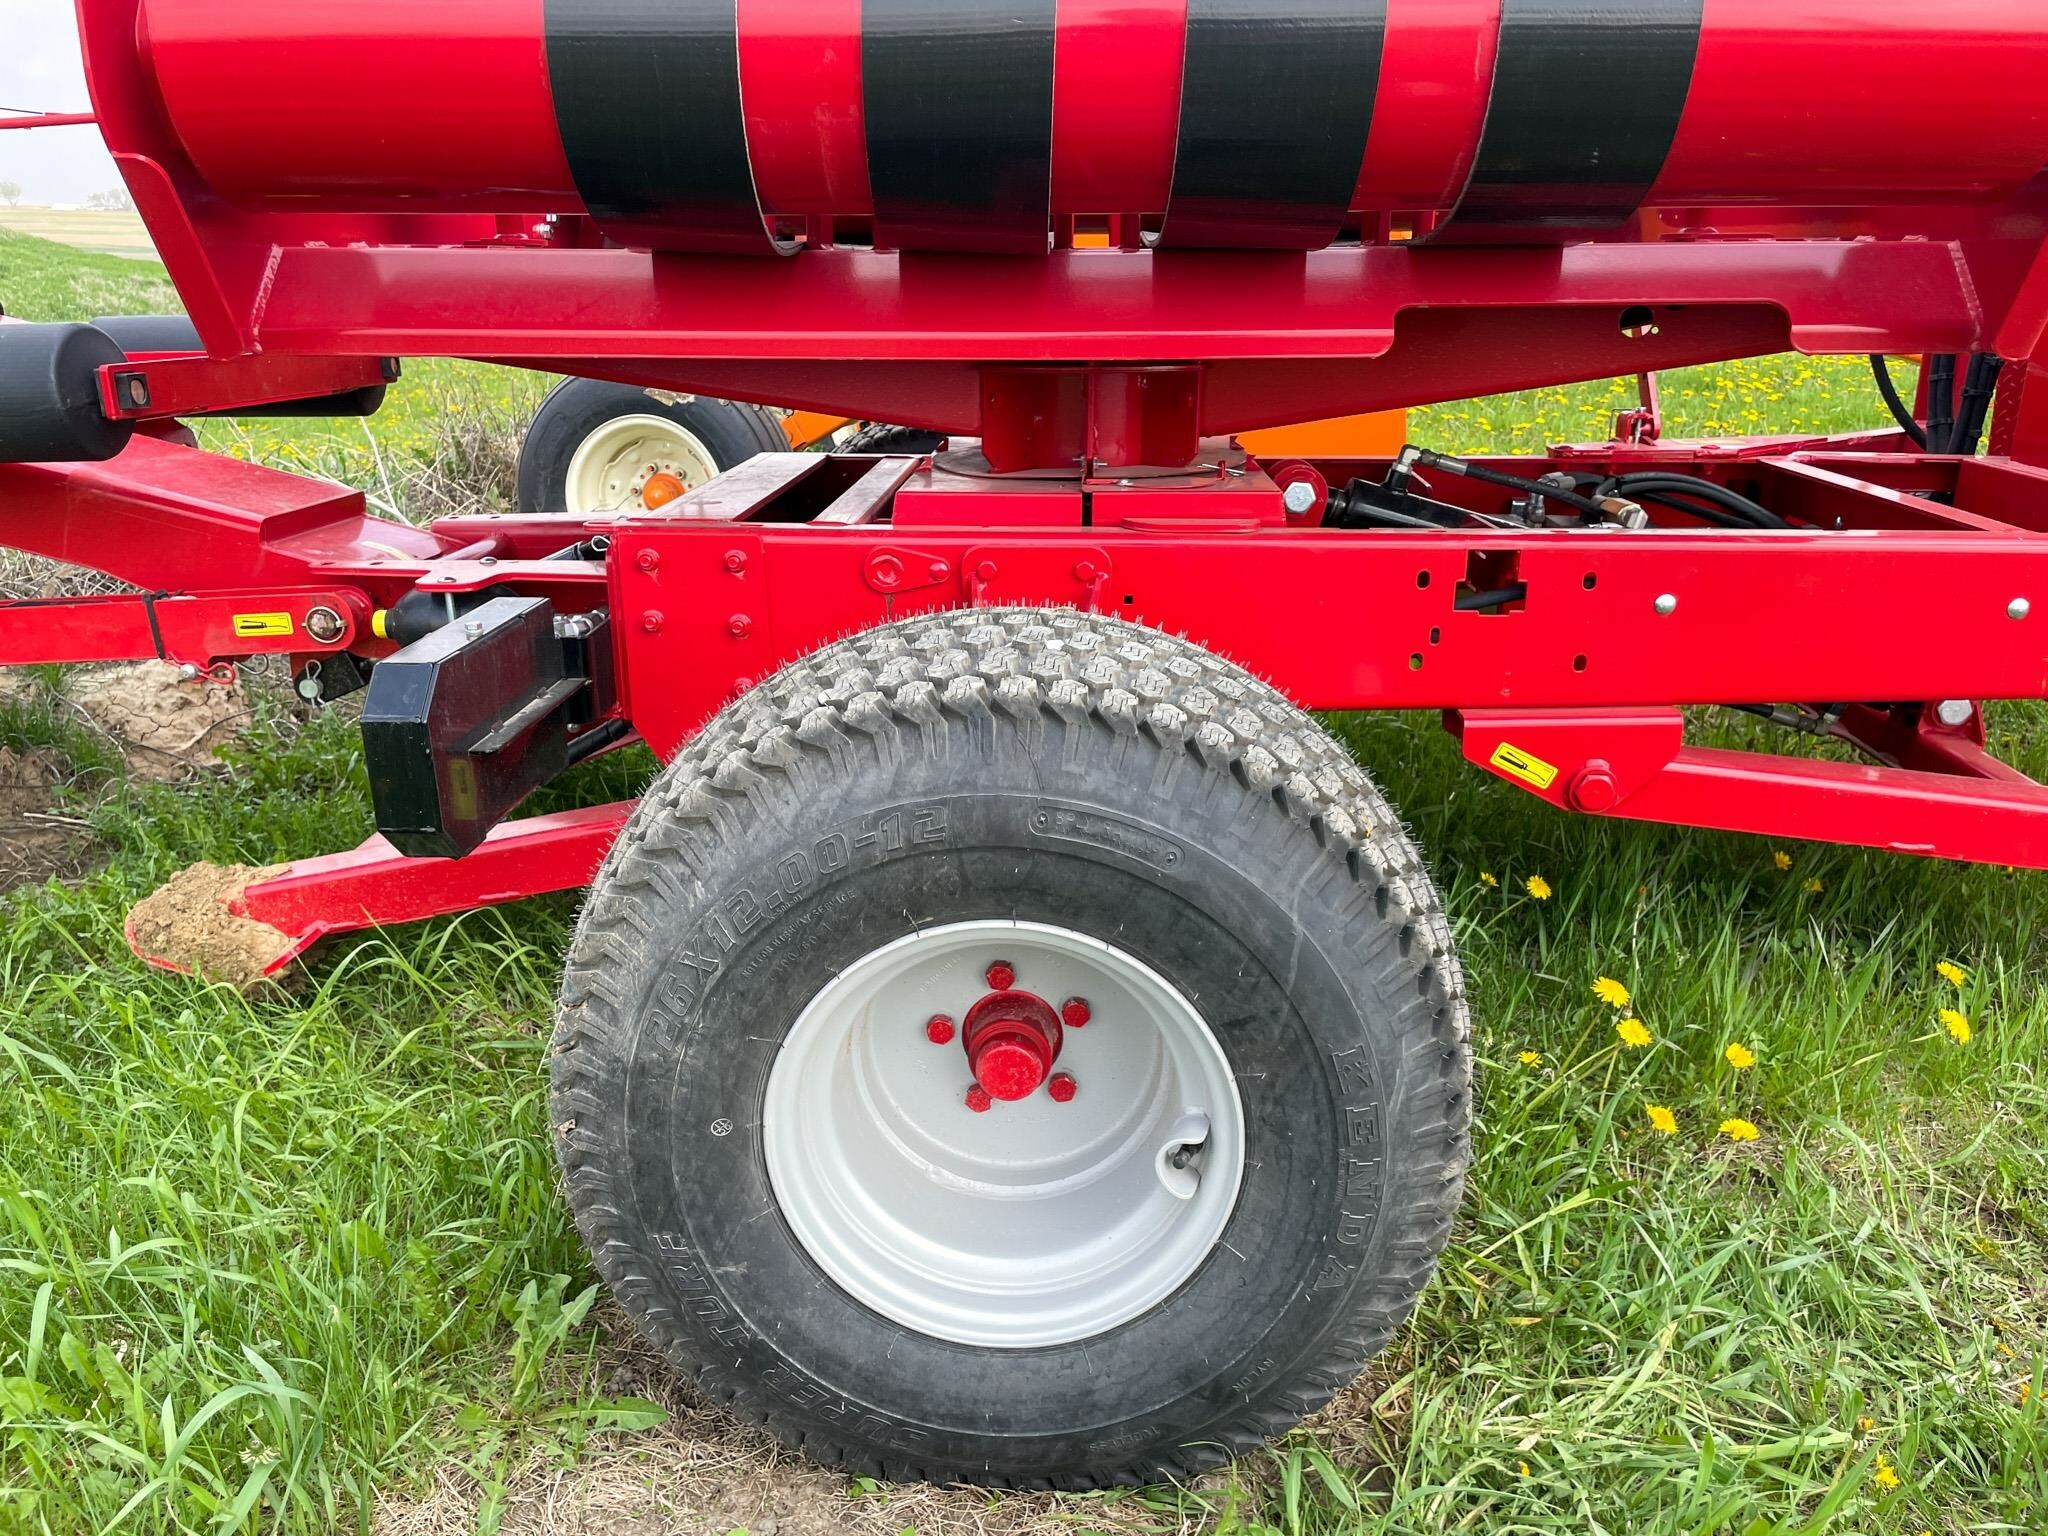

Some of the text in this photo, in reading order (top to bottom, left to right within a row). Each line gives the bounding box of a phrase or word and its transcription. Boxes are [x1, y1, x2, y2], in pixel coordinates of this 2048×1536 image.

[645, 806, 948, 1050] 26X12.00-12
[741, 887, 856, 977] NOT FOR HIGHWAY SERVICE
[1312, 1043, 1381, 1291] KENDA
[651, 1232, 928, 1450] SUPER TURF
[1231, 1357, 1275, 1393] NYLON
